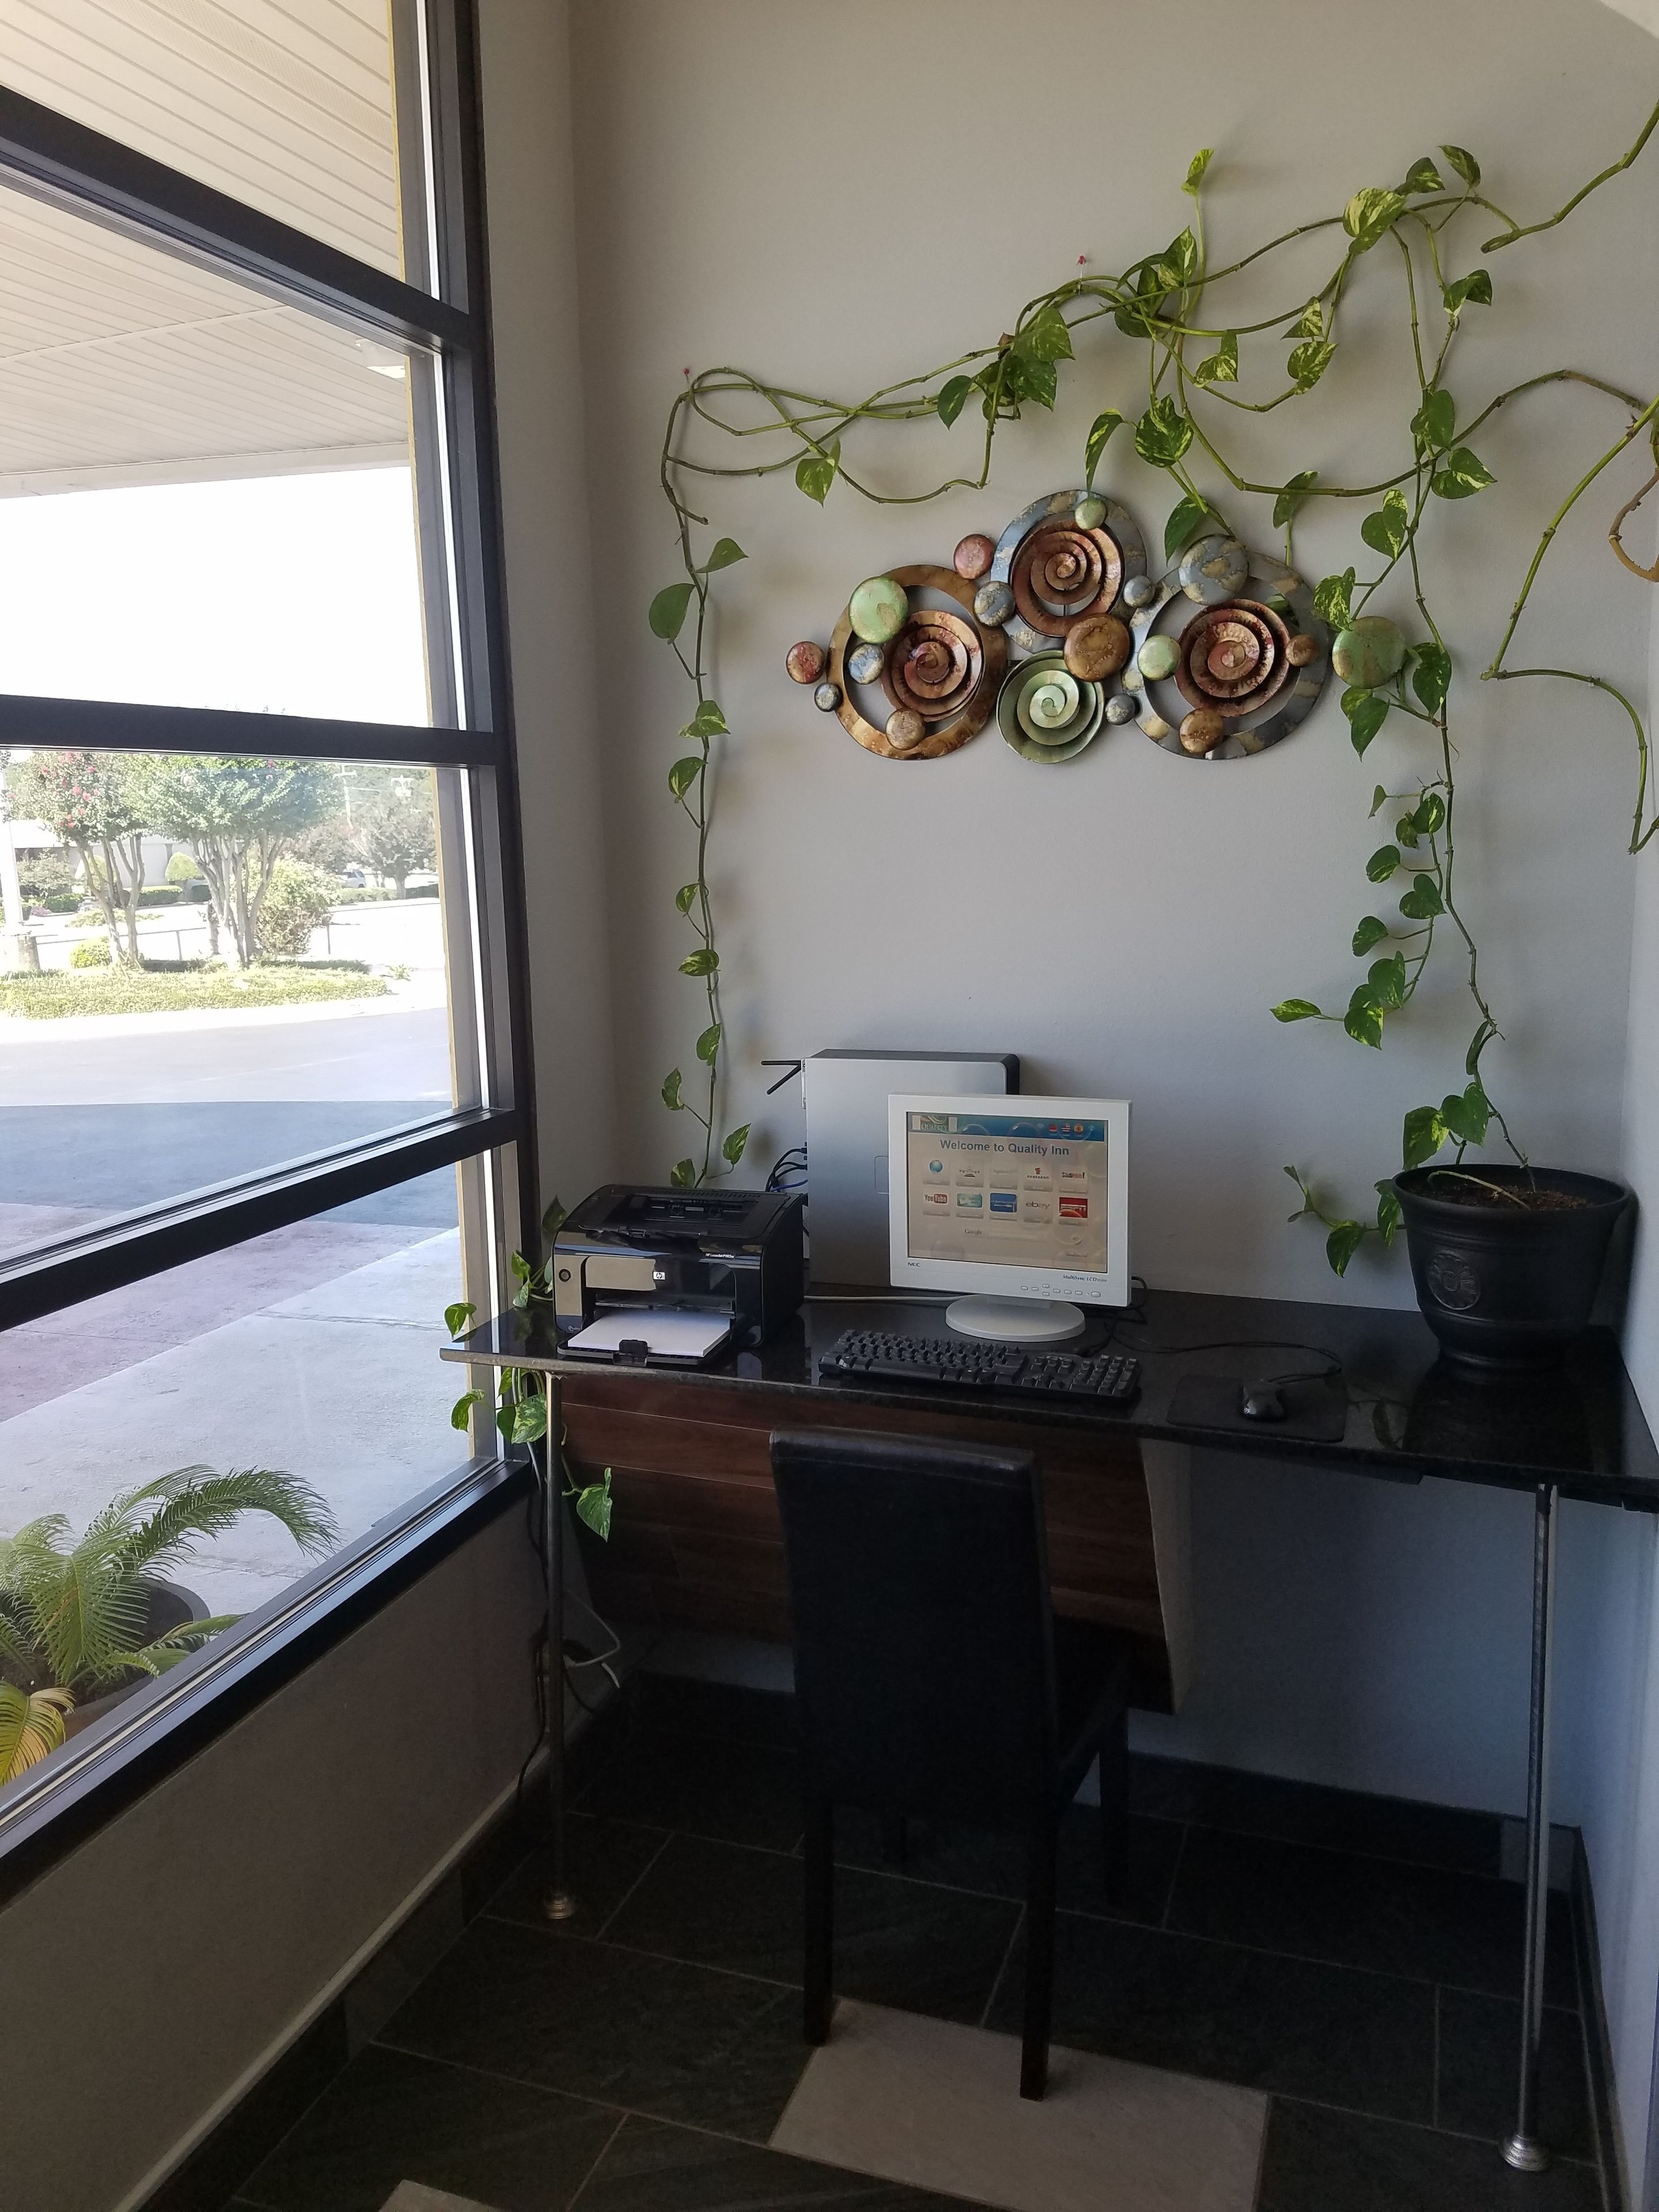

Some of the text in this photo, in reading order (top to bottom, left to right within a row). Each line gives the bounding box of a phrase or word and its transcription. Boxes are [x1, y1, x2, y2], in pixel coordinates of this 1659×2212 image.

[940, 1140, 1070, 1156] Welcome to Quality Inn
